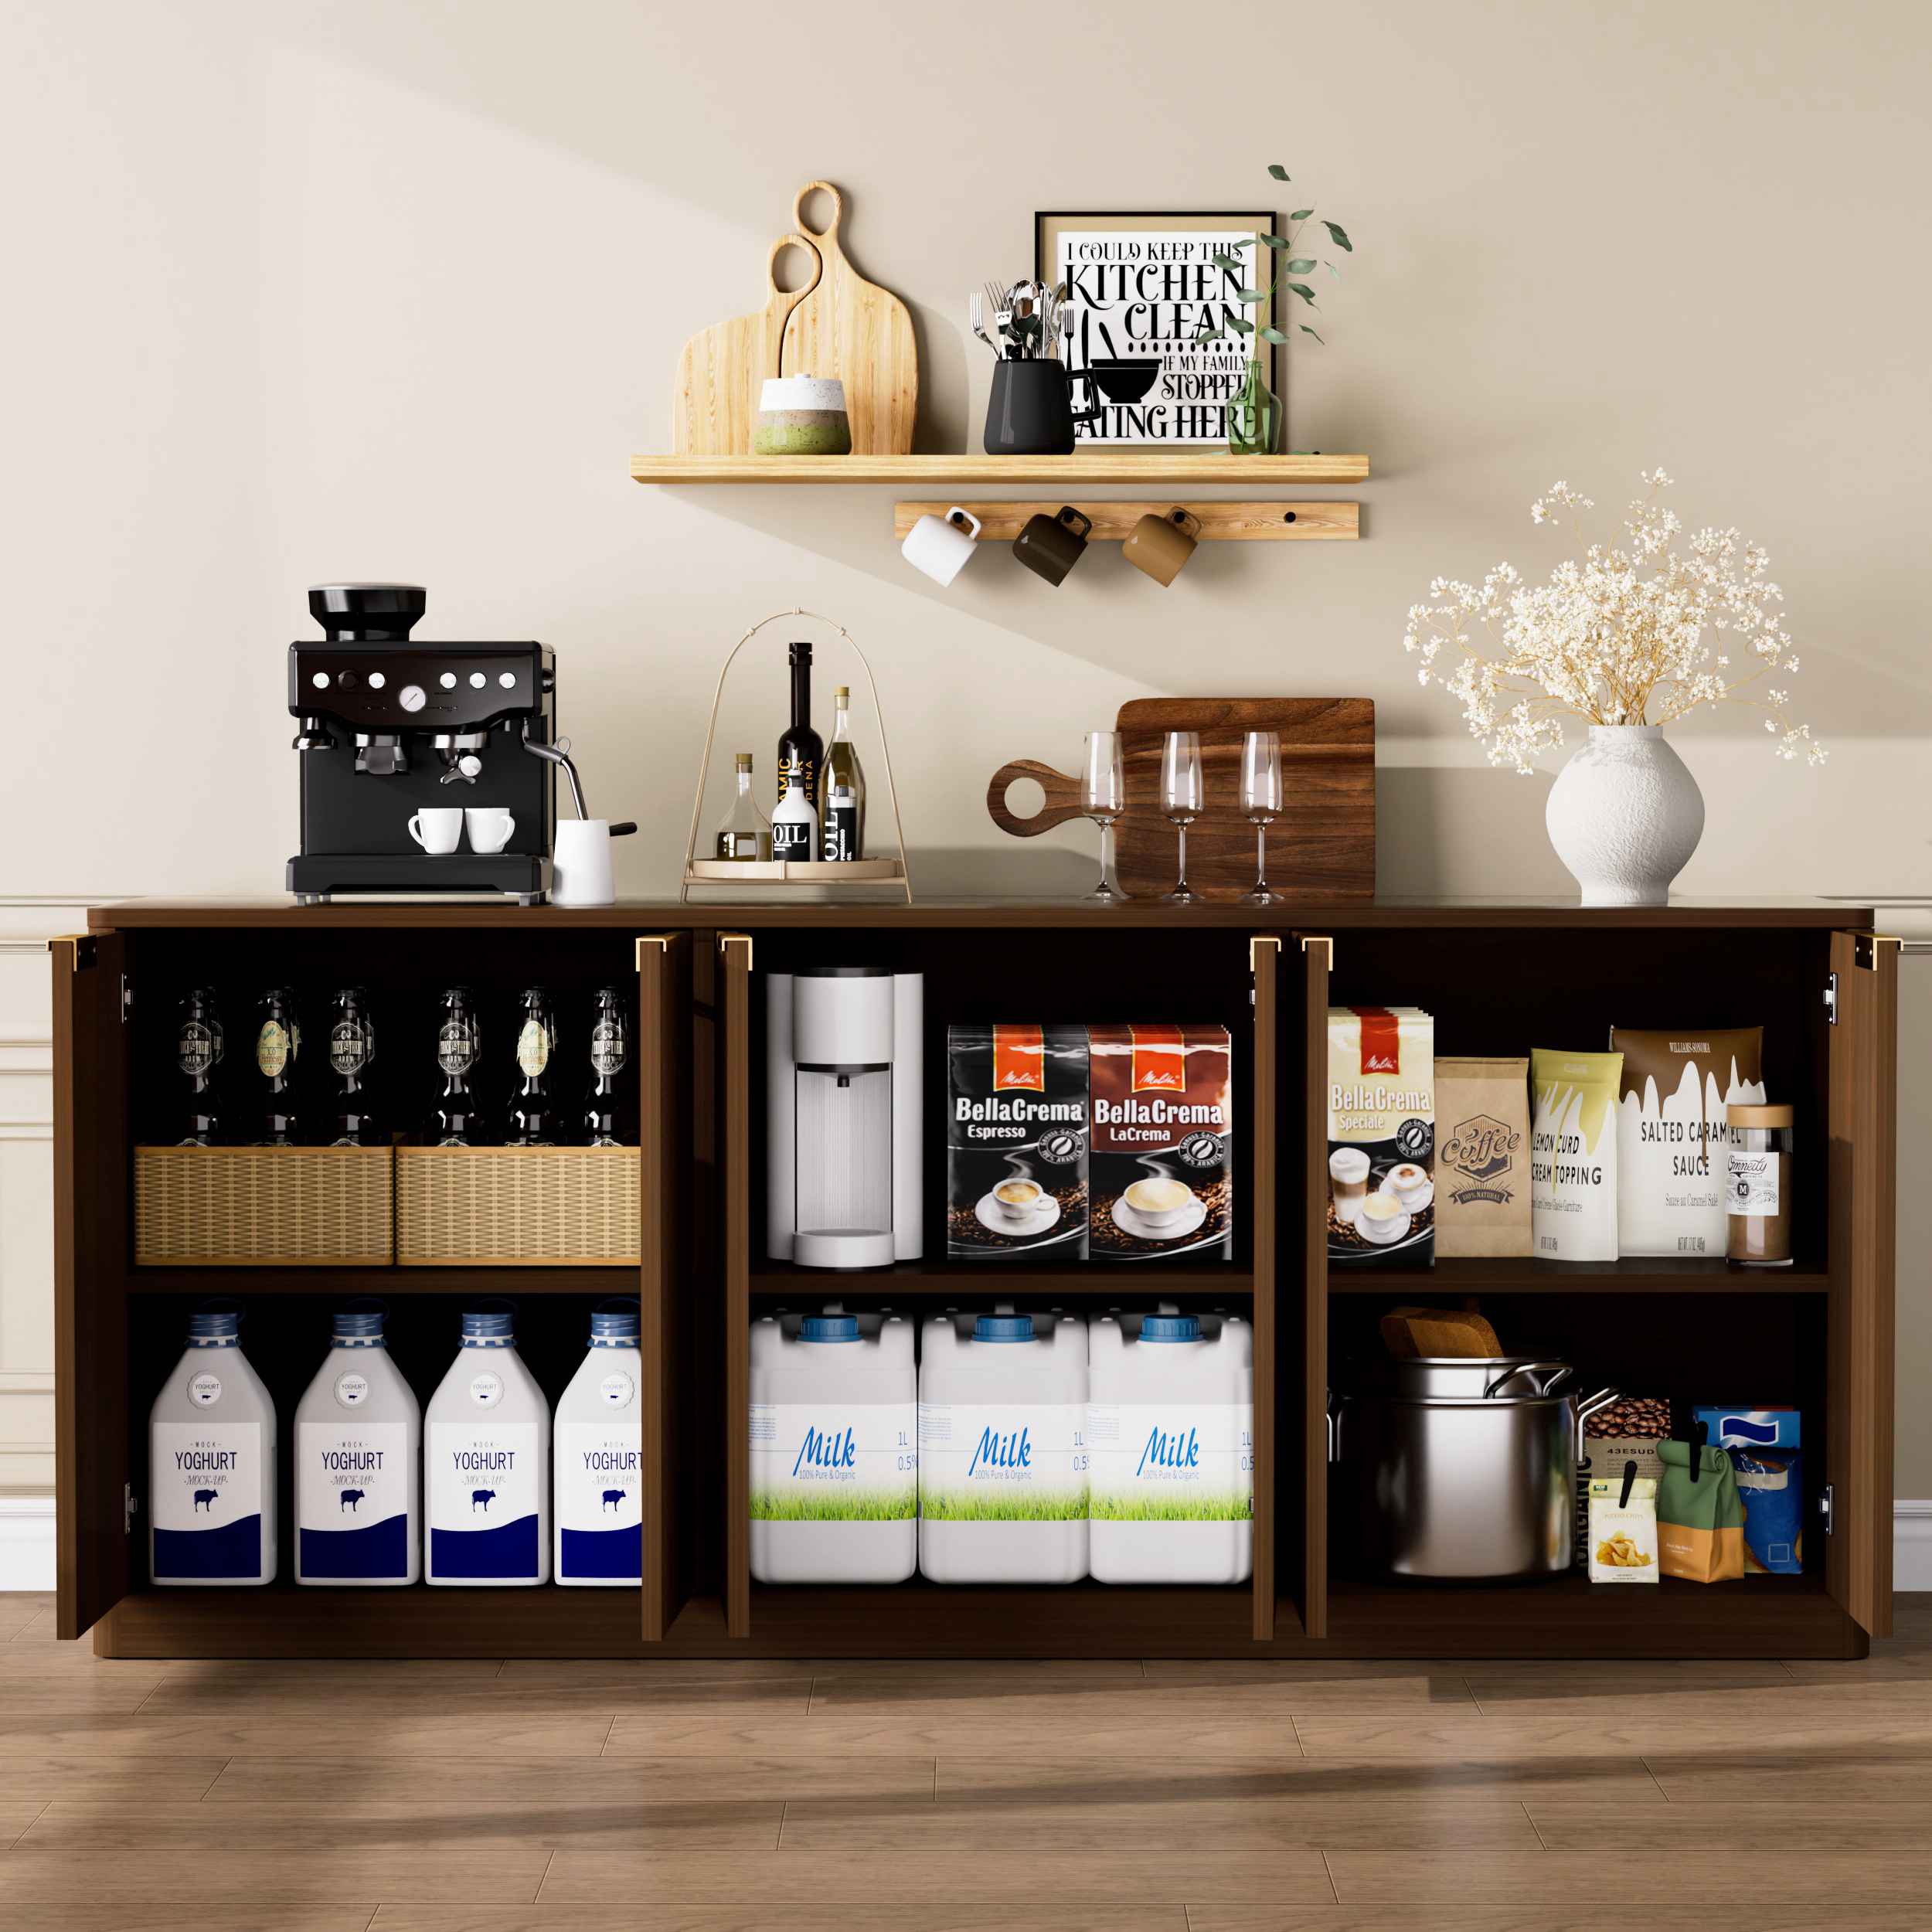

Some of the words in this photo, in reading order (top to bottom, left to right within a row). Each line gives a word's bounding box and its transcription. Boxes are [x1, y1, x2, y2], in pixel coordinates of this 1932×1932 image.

[1067, 243, 1073, 260] I
[1079, 243, 1141, 260] COULD
[1148, 243, 1194, 260] KEEP
[1199, 243, 1243, 260] THIS
[1064, 264, 1248, 310] KITCHEN
[1124, 303, 1247, 340] CLEAN
[1163, 355, 1175, 371] IF
[1179, 355, 1198, 371] MY
[1202, 355, 1248, 371] FAMILY
[1172, 405, 1256, 444] HERE
[774, 825, 807, 843] OIL
[825, 811, 838, 862] OIL
[1331, 1083, 1431, 1112] BellaCrema
[955, 1097, 1083, 1122] BellaCrema
[1094, 1099, 1224, 1124] BellaCrema
[968, 1124, 1026, 1141] Espresso
[1338, 1114, 1385, 1132] Speciale
[1641, 1121, 1684, 1142] SALTED
[1110, 1127, 1171, 1142] LaCrema
[1532, 1133, 1555, 1152] LEMON
[1557, 1134, 1580, 1155] CURD
[1440, 1129, 1520, 1165] Coffee
[1532, 1162, 1552, 1182] CREAM
[1555, 1165, 1602, 1185] TOPPING
[1673, 1155, 1709, 1176] SAUCE
[1462, 1192, 1477, 1201] 100%
[1477, 1191, 1500, 1201] NATURAL
[1665, 1192, 1679, 1206] Sauce
[1680, 1197, 1686, 1206] au
[1687, 1192, 1707, 1206] Caramel
[1739, 1185, 1747, 1195] M
[898, 1431, 908, 1446] 1L
[1073, 1431, 1083, 1446] 1L
[1242, 1431, 1251, 1446] 1L
[175, 1451, 237, 1471] YOGHURT
[321, 1451, 384, 1471] YOGHURT
[453, 1451, 515, 1471] YOGHURT
[583, 1452, 642, 1470] YOGHURT
[792, 1426, 855, 1477] Milk
[968, 1426, 1031, 1477] Milk
[1136, 1426, 1199, 1477] Milk
[799, 1470, 814, 1479] 100%
[815, 1470, 828, 1479] Pure
[829, 1470, 834, 1479] &
[835, 1470, 855, 1481] Organic
[975, 1470, 989, 1479] 100%
[991, 1470, 1003, 1479] Pure
[1005, 1470, 1009, 1479] &
[1010, 1470, 1032, 1481] Organic
[1143, 1470, 1158, 1479] 100%
[1159, 1470, 1171, 1479] Pure
[1172, 1470, 1178, 1479] &
[1179, 1470, 1199, 1481] Organic
